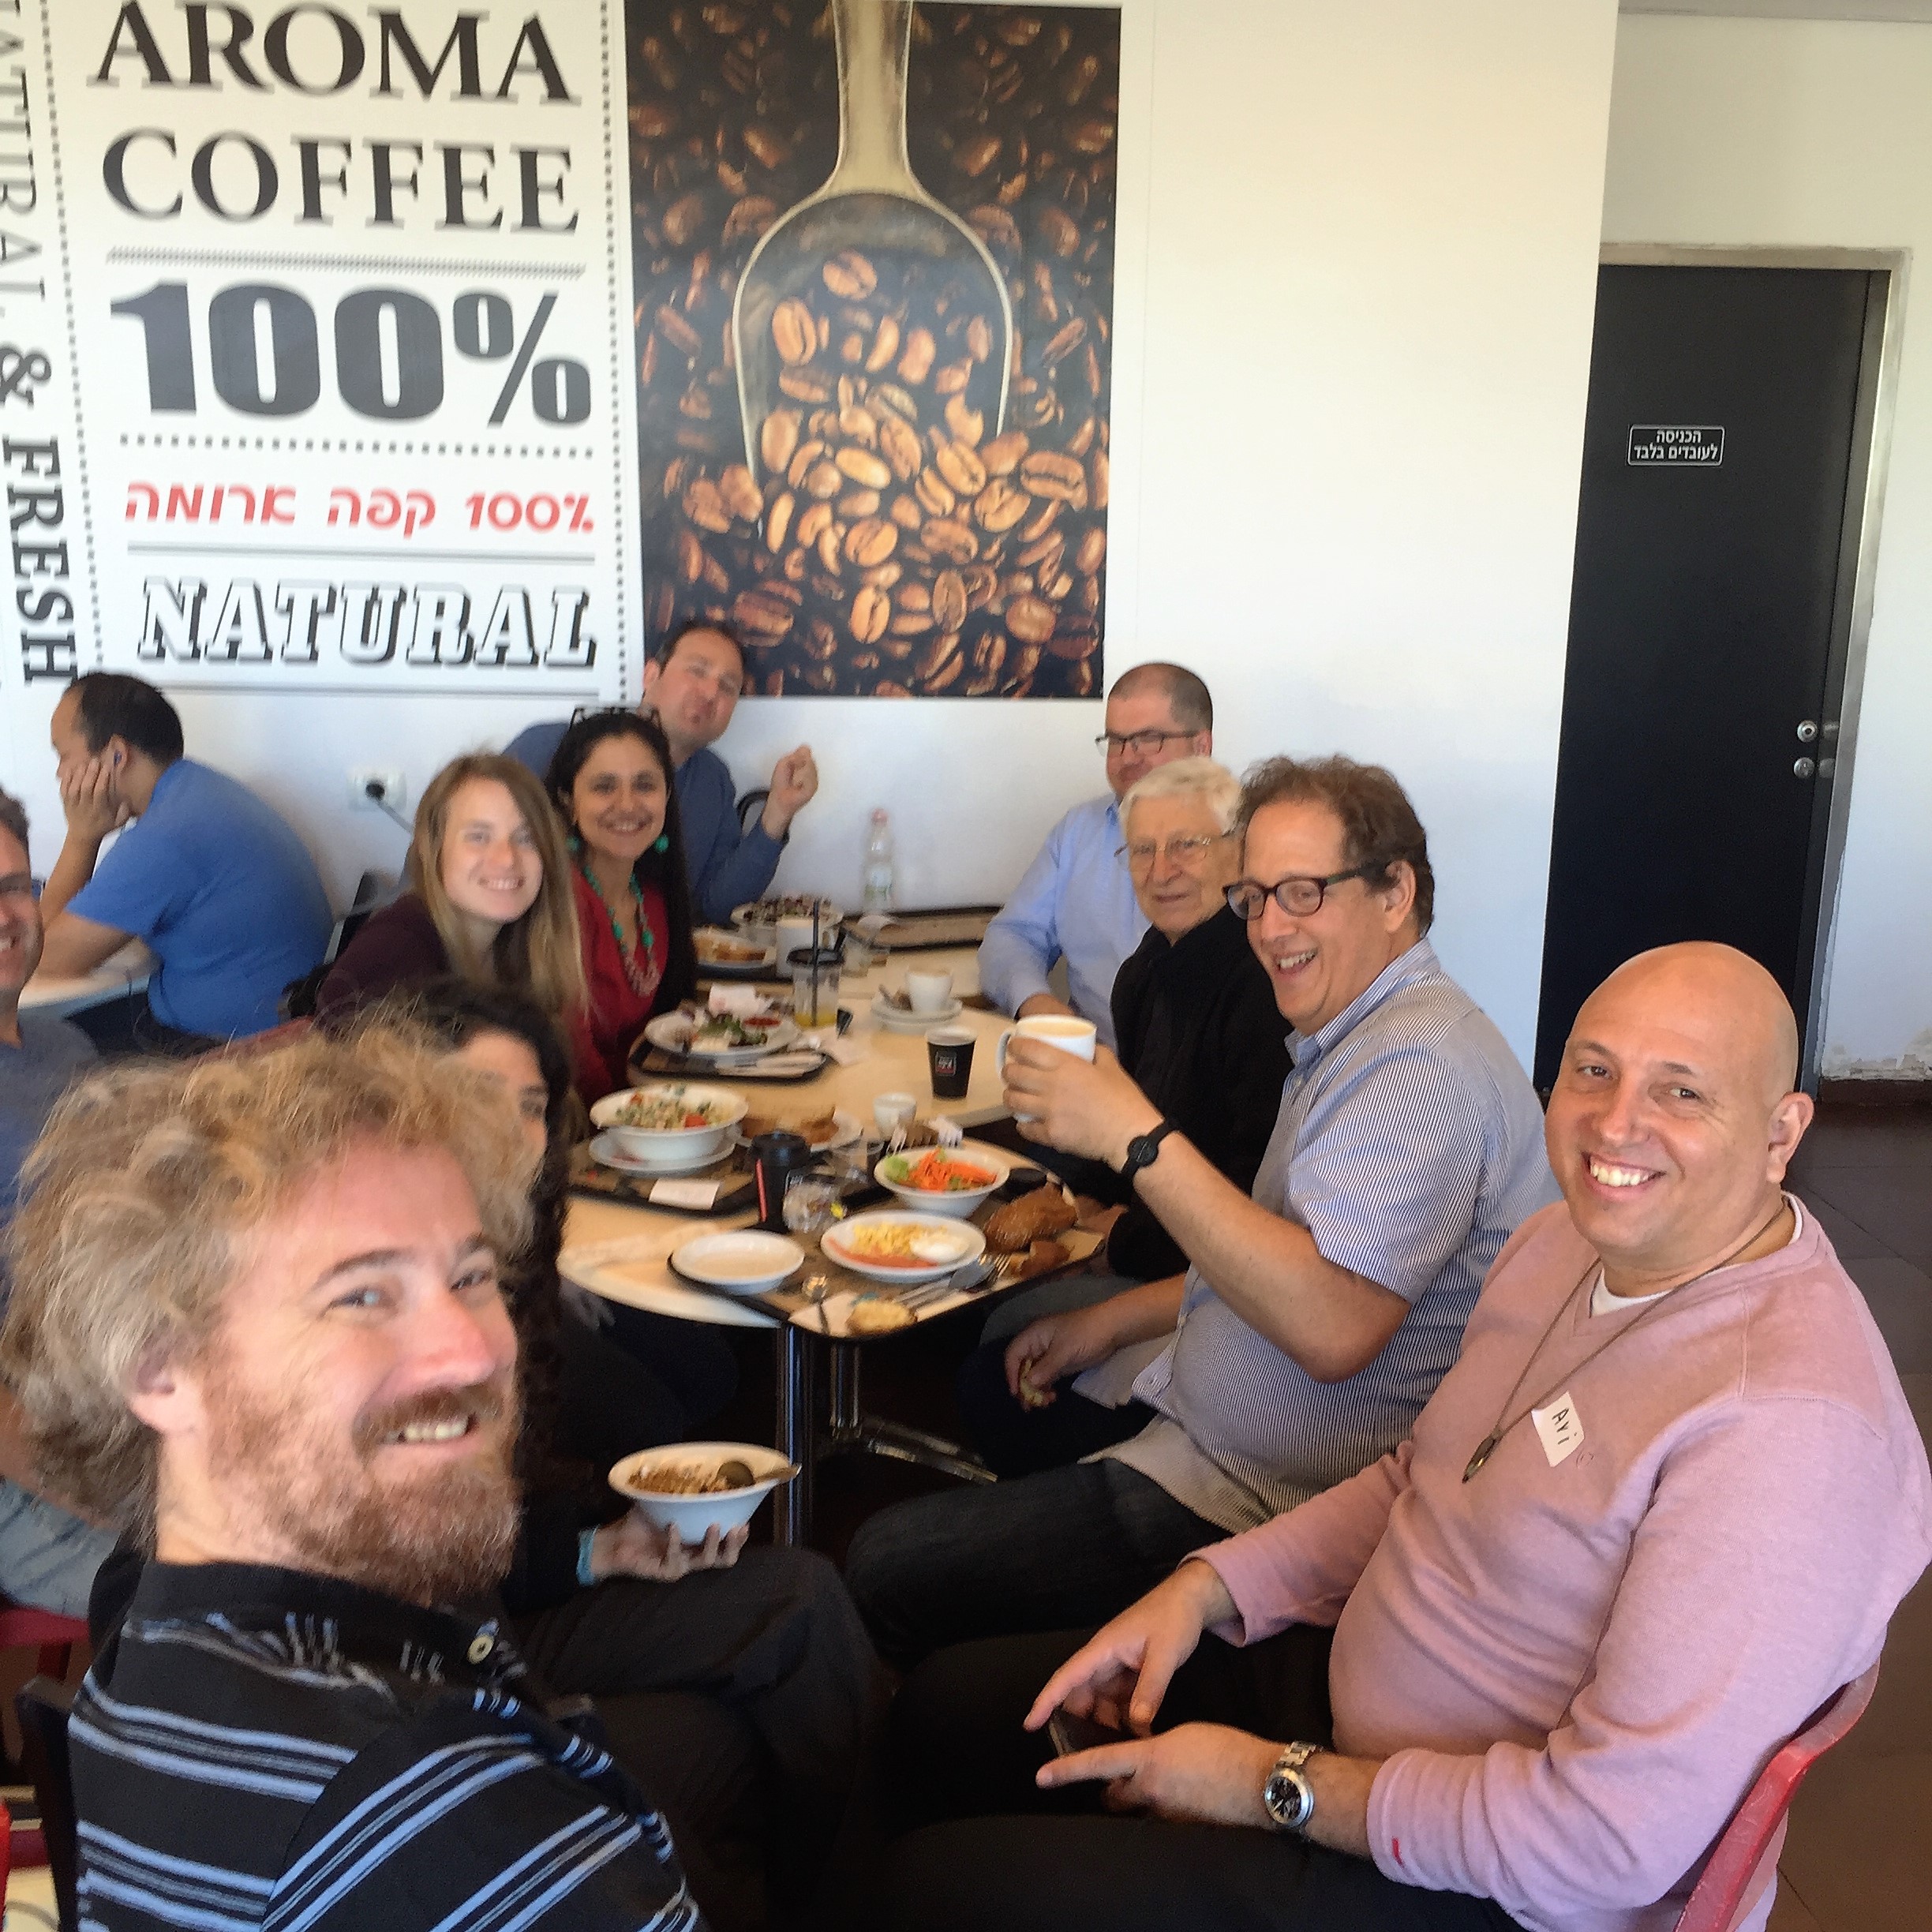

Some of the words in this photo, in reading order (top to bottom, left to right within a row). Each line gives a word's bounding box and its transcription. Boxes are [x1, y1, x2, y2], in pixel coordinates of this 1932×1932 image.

[86, 0, 581, 106] AROMA
[103, 127, 578, 234] COFFEE
[0, 345, 51, 409] &
[110, 278, 591, 427] 100%
[1634, 442, 1664, 459] בלבד
[1656, 429, 1702, 444] הכניסה
[1668, 443, 1718, 461] לעובדים
[125, 481, 296, 524] ארומה
[327, 485, 436, 539] קפה
[465, 490, 594, 534] 100%
[2, 432, 79, 687] FRESH
[137, 576, 598, 670] NATURAL
